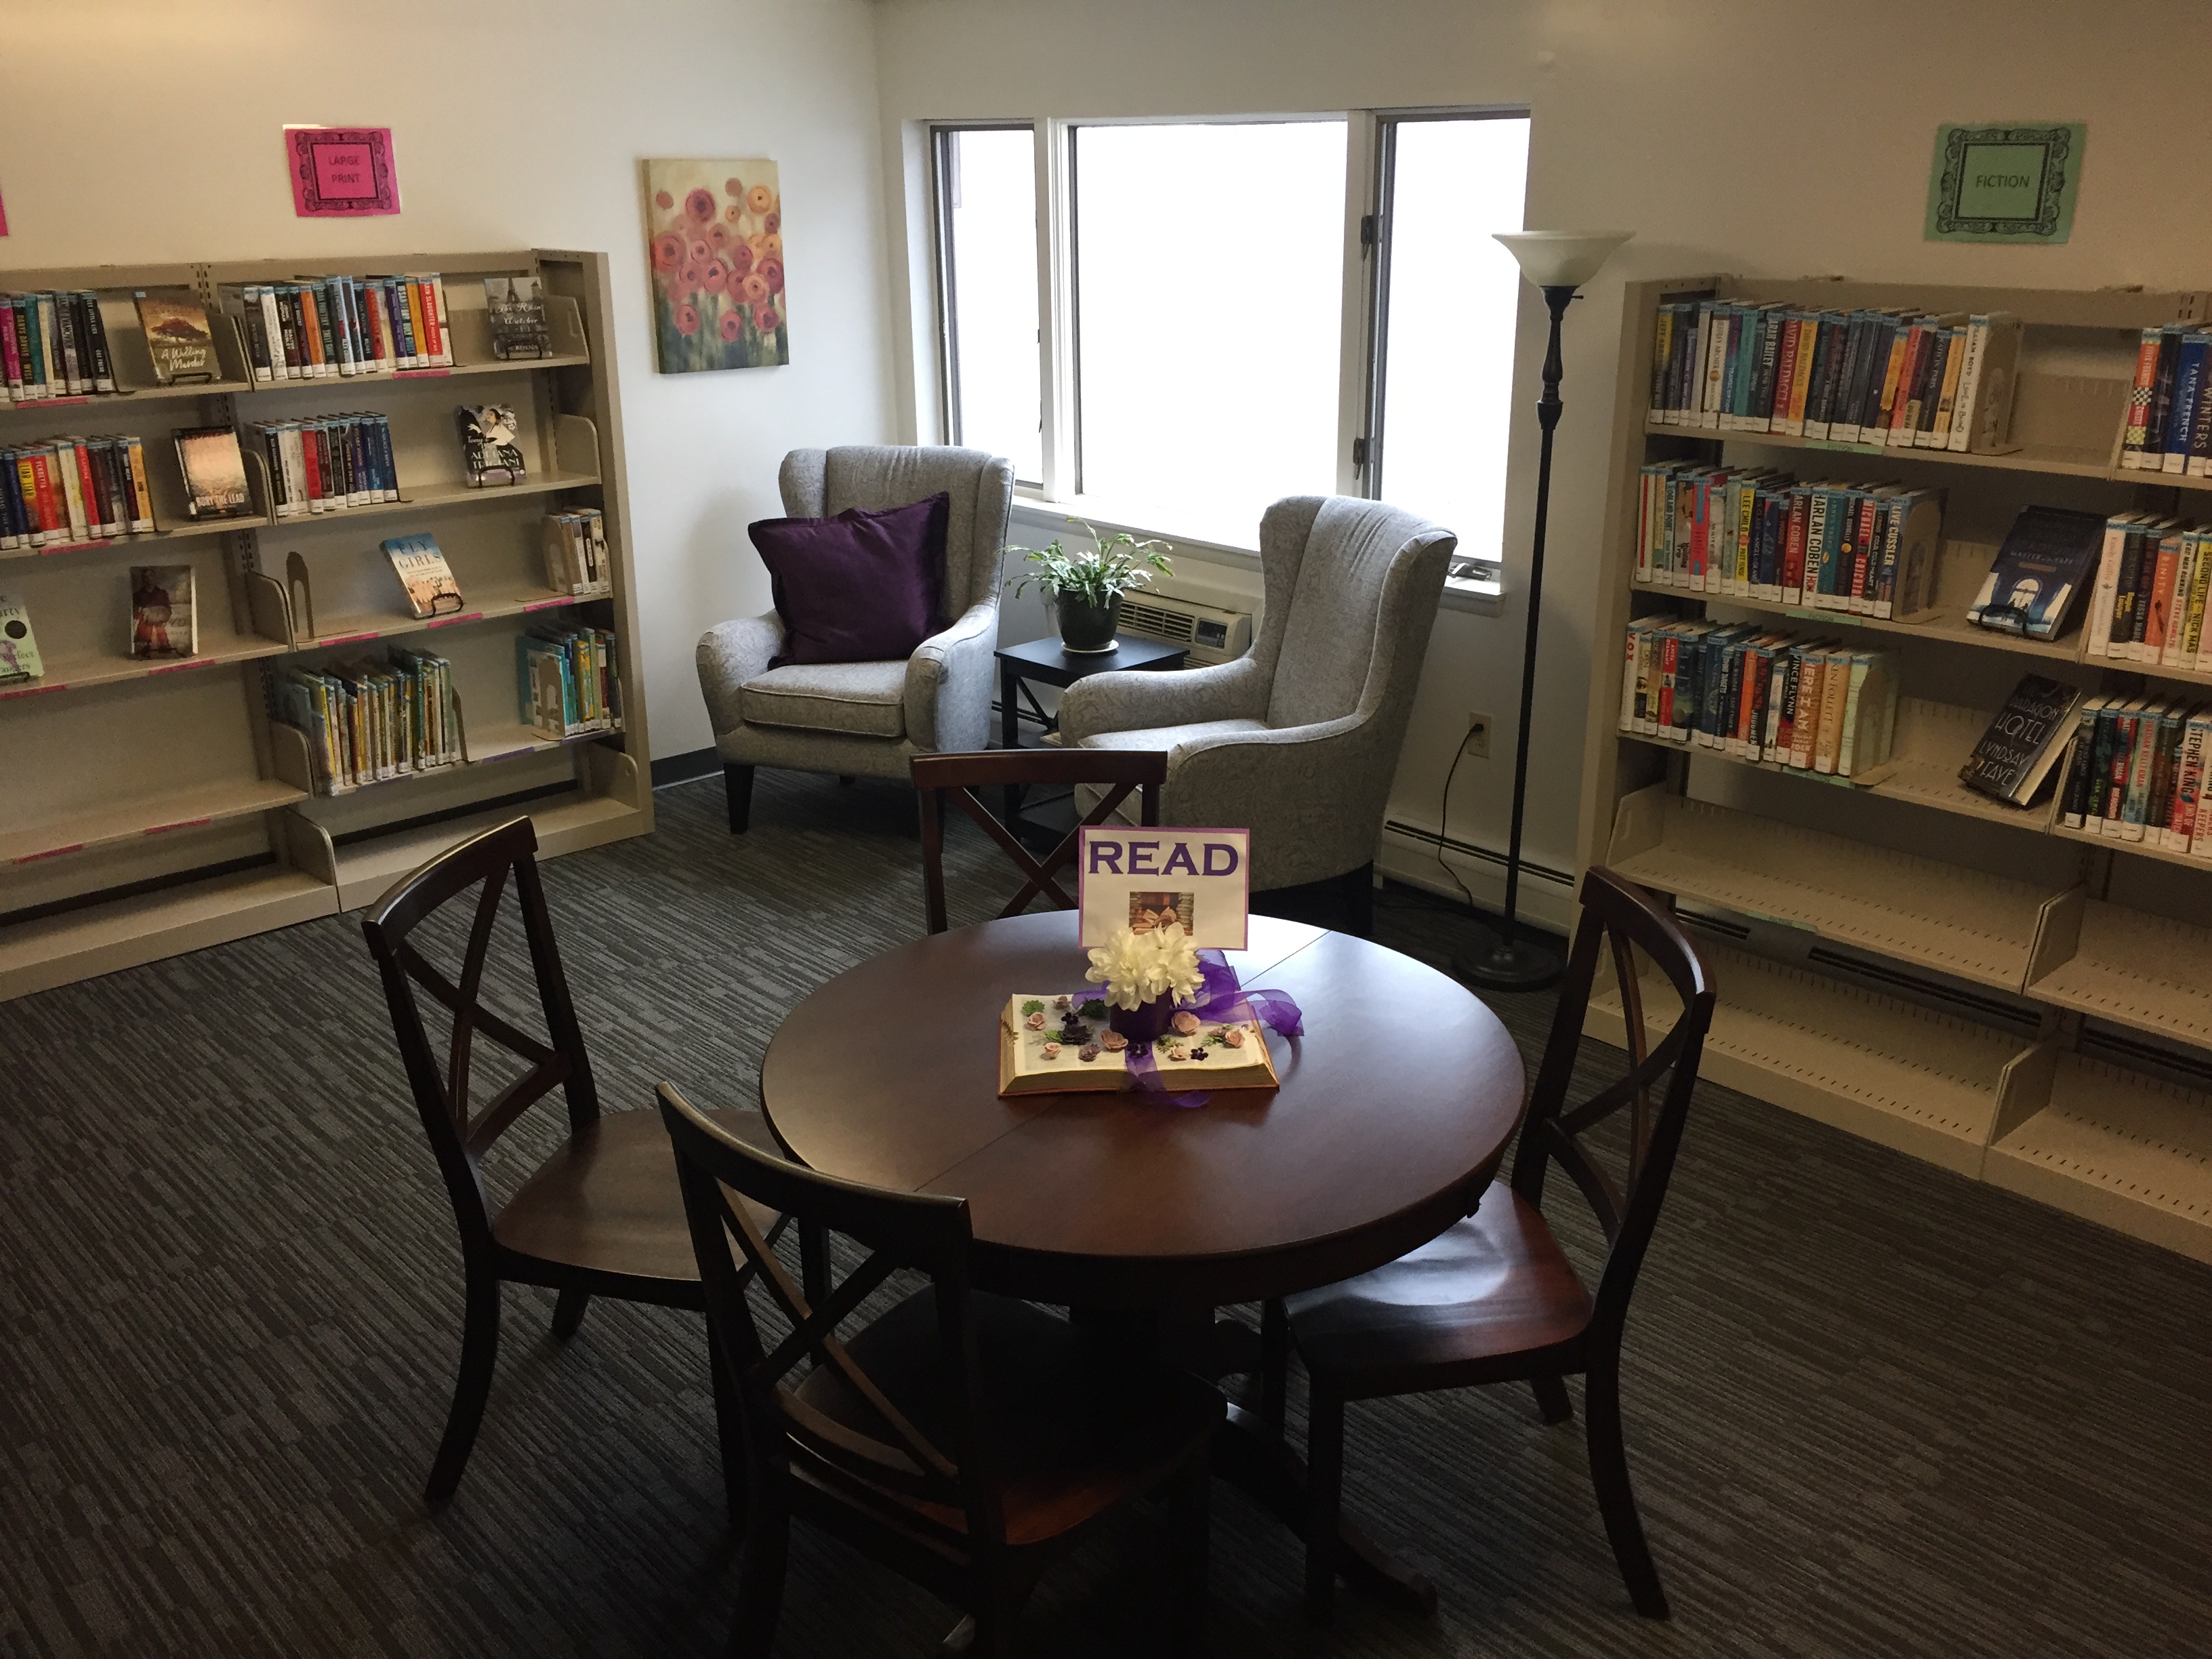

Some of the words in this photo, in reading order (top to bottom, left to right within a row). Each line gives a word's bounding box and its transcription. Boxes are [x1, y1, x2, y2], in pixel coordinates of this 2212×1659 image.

[328, 155, 361, 167] LARGE
[331, 173, 361, 184] PRINT
[1975, 173, 2029, 189] FICTION
[423, 283, 431, 295] ARIN
[425, 295, 436, 327] SLAUGHTER
[504, 315, 539, 325] Watcher
[1765, 319, 1778, 340] ARAH
[1802, 329, 1811, 350] DAVID
[19, 335, 30, 357] DAVIES
[161, 348, 169, 359] A
[171, 345, 207, 361] Willing
[1761, 341, 1776, 367] BAILEY
[169, 356, 206, 371] Murder
[1712, 346, 1722, 370] ARCHER
[1965, 356, 1974, 376] BOYD
[24, 363, 34, 380] WEST
[1777, 350, 1795, 401] BALDACCI
[1797, 352, 1808, 388] BALDACCI
[1929, 370, 1939, 390] PARIS
[2186, 363, 2200, 393] TANA
[1723, 367, 1735, 413] TRANSCRIPTION
[1956, 411, 1967, 432] BLIND
[2179, 398, 2194, 442] FRENCH
[2193, 387, 2212, 449] WINTERS
[228, 493, 245, 505] LEAD
[1742, 494, 1750, 508] LEE
[1790, 494, 1804, 524] ARLAN
[1740, 510, 1750, 533] CHILD
[1889, 506, 1902, 525] LIVE
[1777, 520, 1785, 545] WOODS
[1786, 525, 1801, 554] COBEN
[1805, 537, 1821, 574] COBEN
[1883, 525, 1898, 567] CUSSLER
[398, 552, 443, 570] GIRLS
[1738, 560, 1746, 577] TENSE
[1870, 552, 1878, 567] COLD
[2198, 552, 2209, 586] SECOND
[1805, 575, 1816, 593] HOME
[1867, 567, 1875, 587] HEART
[2156, 555, 2169, 596] RINITY
[2177, 571, 2188, 598] RUNNING
[2194, 586, 2205, 605] LIFE
[2135, 600, 2146, 621] TESSA
[2173, 599, 2182, 619] STEVE
[2131, 622, 2142, 643] HADL
[2190, 613, 2200, 632] NICK
[1626, 633, 1635, 661] VOX
[2186, 634, 2198, 654] MAS
[1788, 655, 1801, 683] VINCE
[1719, 674, 1728, 693] TARGETS
[1784, 684, 1797, 716] FLYNN
[1800, 696, 1811, 707] I
[1824, 682, 1837, 722] FOLLETT
[2010, 695, 2060, 722] PARAGON
[1749, 710, 1760, 745] JUDGMEN
[1797, 709, 1809, 731] AM
[1994, 712, 2045, 744] HOTEL
[1979, 741, 2028, 767] LYNDSAY
[2186, 728, 2204, 769] STEPHEN
[1980, 762, 2015, 786] FAYE
[2136, 750, 2149, 788] KELLERMAN
[2094, 778, 2102, 794] LISA
[2181, 770, 2196, 794] KING
[2186, 804, 2195, 815] END
[2184, 817, 2193, 826] OF
[2193, 808, 2207, 842] KEEPERS
[1088, 840, 1239, 877] READ
